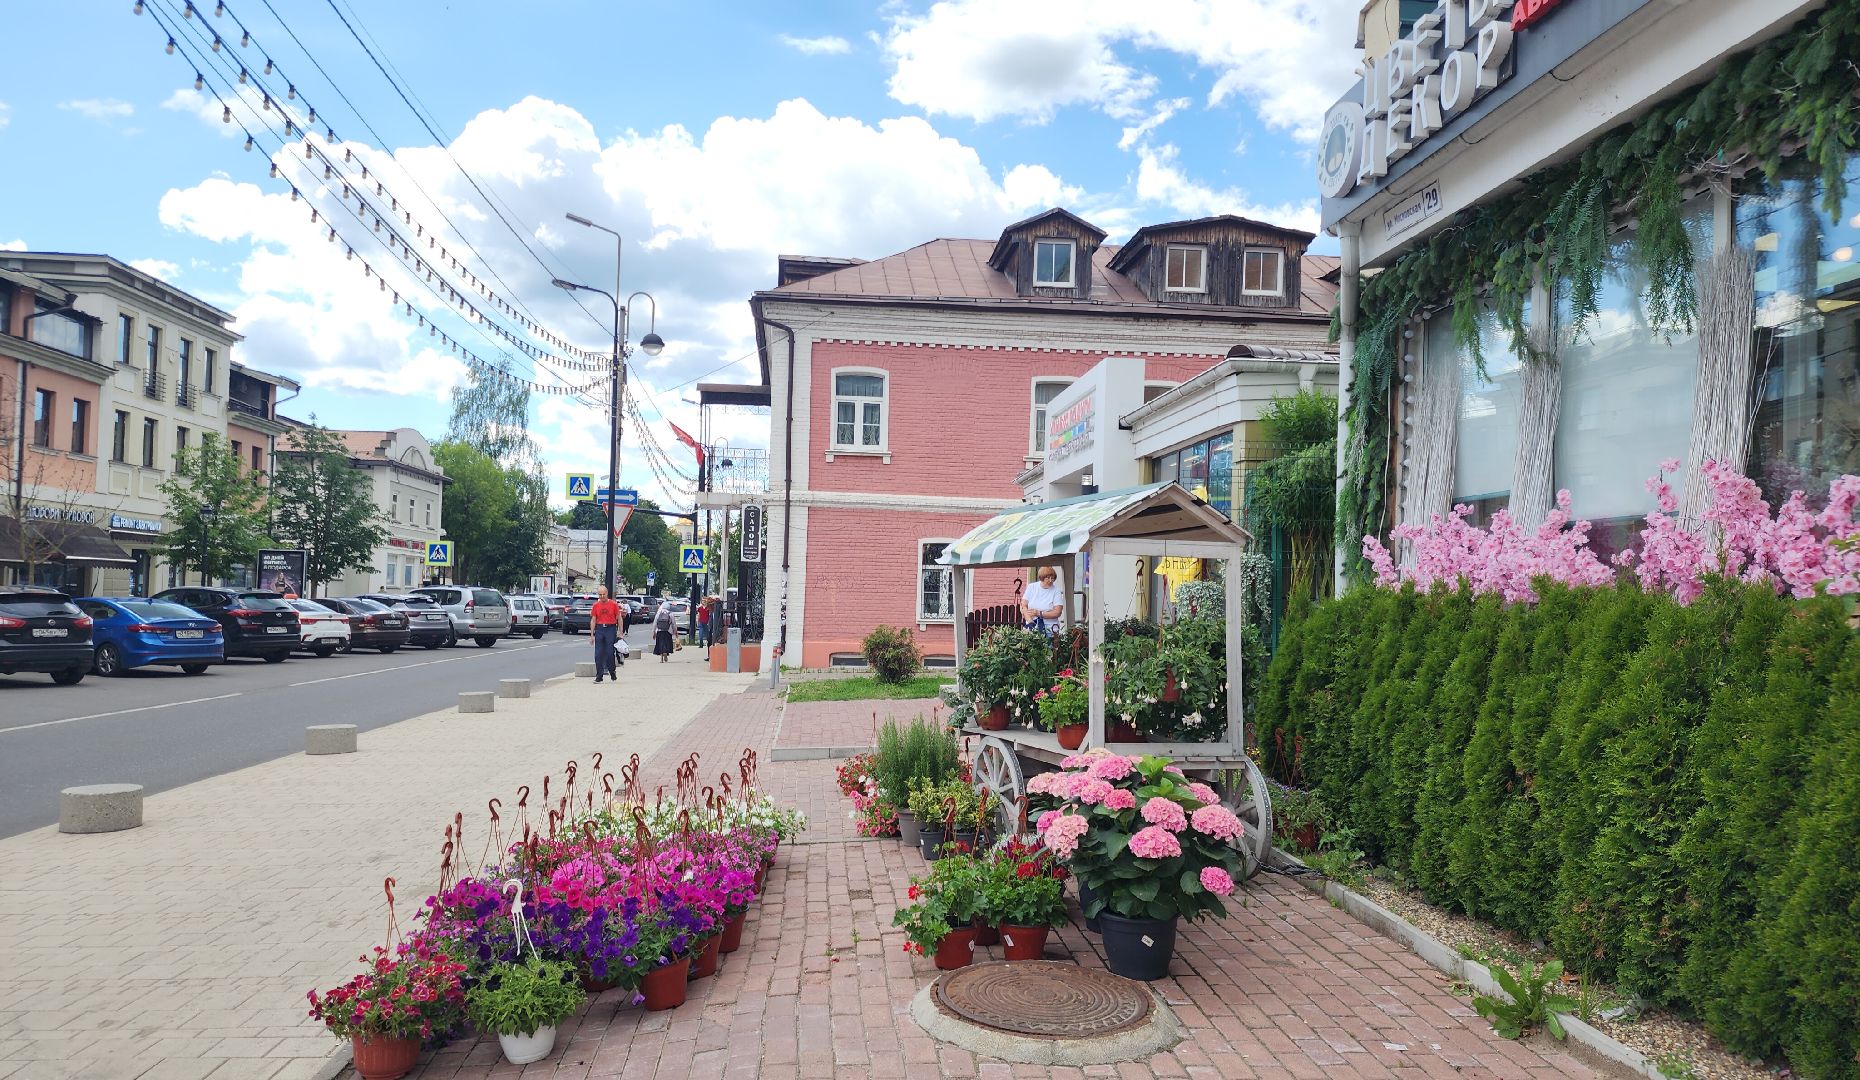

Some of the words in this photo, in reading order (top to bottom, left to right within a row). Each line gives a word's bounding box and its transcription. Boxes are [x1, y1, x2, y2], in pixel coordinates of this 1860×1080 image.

[1356, 20, 1514, 186] ДЕКОР
[1425, 188, 1438, 210] 29
[120, 517, 135, 529] РЕМОНТ
